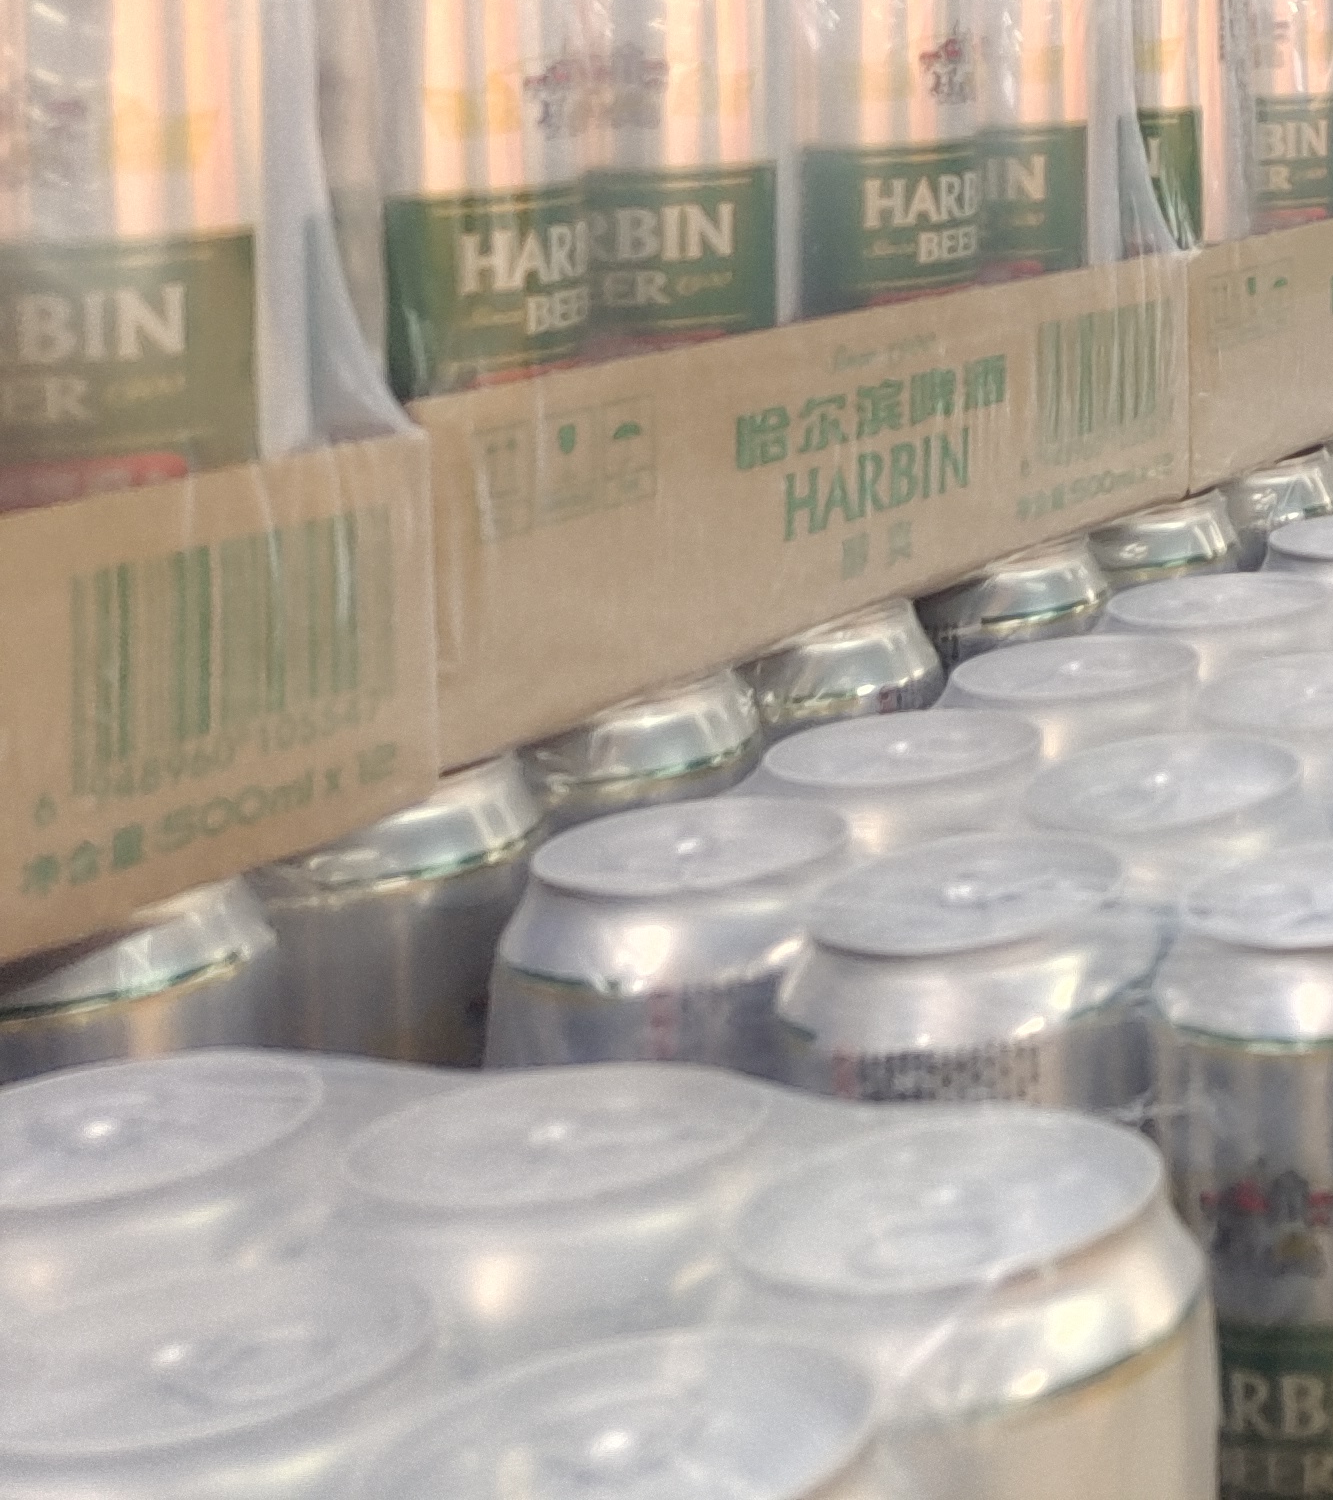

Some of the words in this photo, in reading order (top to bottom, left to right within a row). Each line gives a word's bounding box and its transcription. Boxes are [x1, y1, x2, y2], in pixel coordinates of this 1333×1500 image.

[17, 283, 189, 366] BIN
[735, 353, 1008, 470] 哈尔滨啤酒
[783, 426, 970, 542] HARBIN
